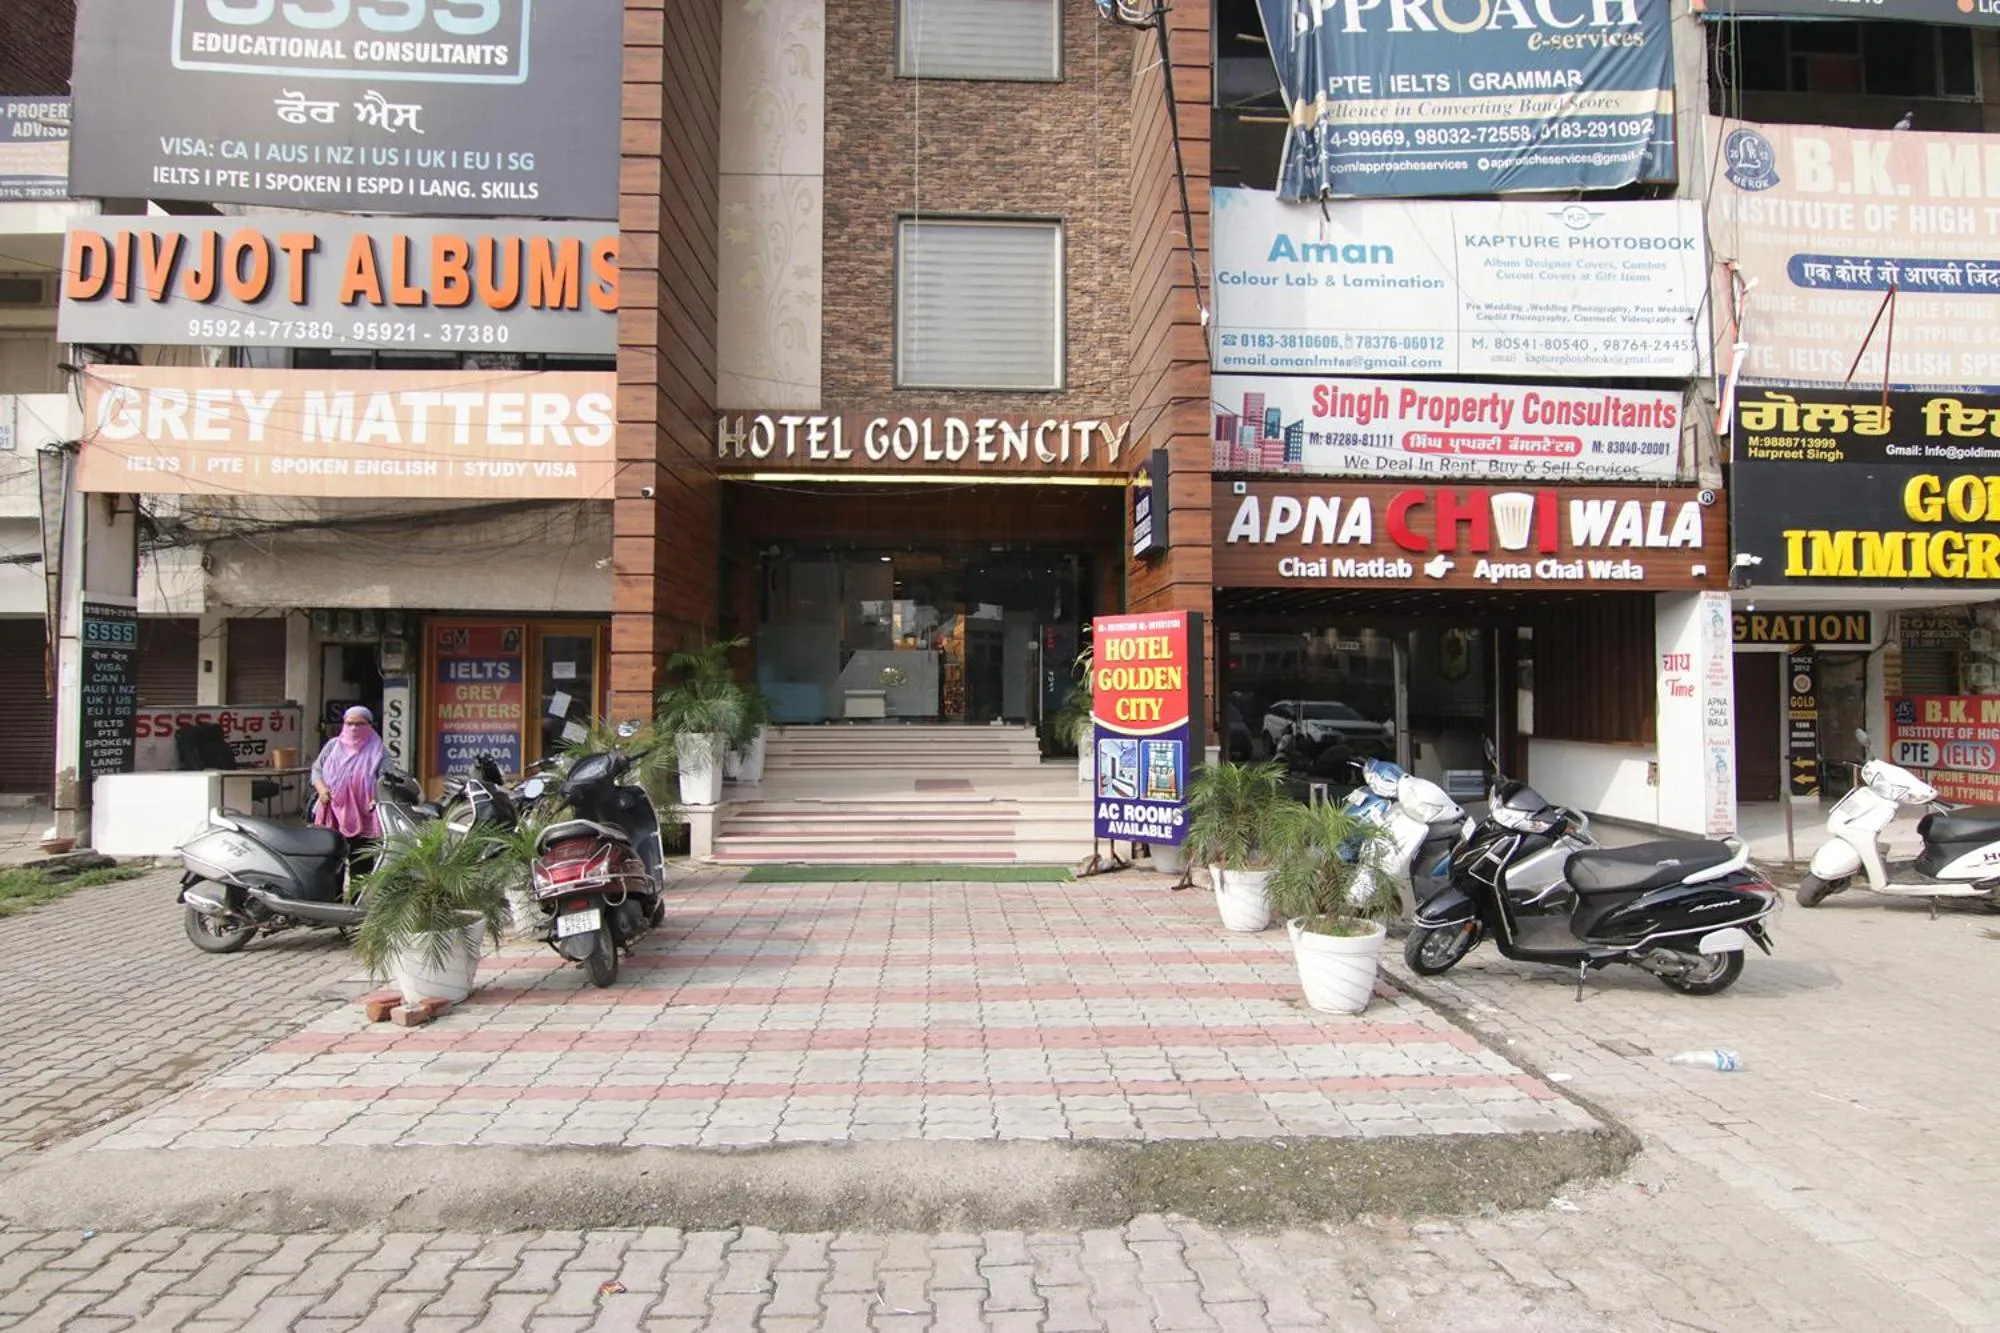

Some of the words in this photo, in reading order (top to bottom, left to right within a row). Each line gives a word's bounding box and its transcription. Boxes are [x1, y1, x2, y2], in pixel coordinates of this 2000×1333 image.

[193, 32, 346, 59] EDUCATIONAL
[354, 41, 508, 65] CONSULTANTS
[1528, 28, 1644, 51] e-services
[1328, 75, 1372, 94] PTE
[1390, 74, 1450, 93] IELTS
[1469, 70, 1583, 90] GRAMMAR
[7, 103, 71, 118] PROPER
[1395, 103, 1410, 116] in
[1418, 99, 1512, 117] Converting
[160, 136, 215, 157] VISA:
[221, 140, 248, 160] CA
[267, 142, 308, 163] AUS
[327, 144, 354, 164] NZ
[372, 145, 399, 166] US
[417, 148, 446, 168] UK
[464, 150, 490, 170] EU
[507, 150, 534, 171] SG
[1793, 137, 1910, 197] B.K.
[153, 166, 199, 185] IELTS
[216, 168, 248, 188] PTE
[265, 170, 341, 192] SPOKEN
[358, 173, 404, 194] ESPD
[420, 176, 477, 198] LANG.
[481, 178, 539, 200] SKILLS
[1721, 195, 1854, 231] INSTITUTE
[1865, 204, 1898, 231] OF
[1909, 206, 1980, 235] HIGH
[1268, 233, 1393, 264] Aman
[1465, 235, 1560, 249] KAPTURE
[1569, 235, 1696, 250] PHOTOBOOK
[68, 230, 318, 303] DIVJOT
[340, 233, 619, 312] ALBUMS
[1218, 270, 1279, 286] Colour
[1285, 272, 1318, 287] Lab
[1325, 274, 1336, 287] &
[1343, 273, 1445, 289] Lamination
[1803, 262, 1832, 285] एक
[1835, 258, 1873, 284] कोर्स
[1877, 257, 1899, 284] जो
[1905, 261, 1963, 286] आपकी
[188, 320, 333, 341] 95924-77380
[353, 322, 417, 342] 95921
[441, 323, 509, 344] 37380
[97, 385, 282, 442] GREY
[304, 390, 613, 449] MATTERS
[1312, 384, 1389, 425] Singh
[1398, 387, 1515, 430] Property
[1522, 392, 1677, 429] Consultants
[1739, 391, 1893, 436] ਗੋਲਡ
[718, 415, 852, 460] HOTEL
[1309, 433, 1322, 446] M:
[1748, 447, 1803, 461] Harpreet
[1807, 448, 1843, 463] Singh
[1886, 444, 1922, 457] Gmail:
[127, 456, 180, 471] IELTS
[207, 457, 242, 473] PTE
[271, 459, 347, 475] SPOKEN
[354, 459, 437, 477] ENGLISH
[464, 460, 525, 478] STUDY
[534, 462, 577, 479] VISA
[1344, 455, 1369, 470] We
[1376, 456, 1413, 471] Deal
[1419, 457, 1433, 471] In
[1488, 459, 1518, 475] Buy
[1524, 460, 1536, 473] &
[1542, 461, 1570, 475] Sell
[1576, 461, 1640, 478] Services
[1226, 495, 1373, 545] APNA
[1569, 499, 1703, 549] WALA
[1278, 557, 1327, 578] Chai
[1332, 557, 1413, 579] Matlab
[1474, 560, 1530, 585] Apna
[1536, 559, 1584, 580] Chai
[1590, 560, 1643, 581] Wala
[1105, 636, 1174, 661] HOTEL
[449, 662, 511, 680] IELTS
[1662, 653, 1691, 672] चाय
[1098, 666, 1182, 691] GOLDEN
[1665, 678, 1695, 697] Time
[456, 685, 504, 701] GREY
[1708, 698, 1728, 707] APNA
[1790, 695, 1815, 708] GOLD
[439, 703, 521, 719] MATTERS
[1116, 697, 1163, 721] CITY
[1708, 708, 1727, 717] CHAI
[1925, 700, 1974, 724] B.K.
[1708, 718, 1729, 727] WALA
[1898, 726, 1954, 738] INSTITUTE
[1958, 727, 1974, 739] OF
[444, 734, 484, 744] STUDY
[487, 734, 516, 744] VISA
[1901, 743, 1929, 762] PTE
[1947, 745, 1991, 767] IELTS
[1098, 803, 1119, 819] AC
[1124, 804, 1184, 826] ROOMS
[1108, 821, 1172, 839] AVAILABLE
